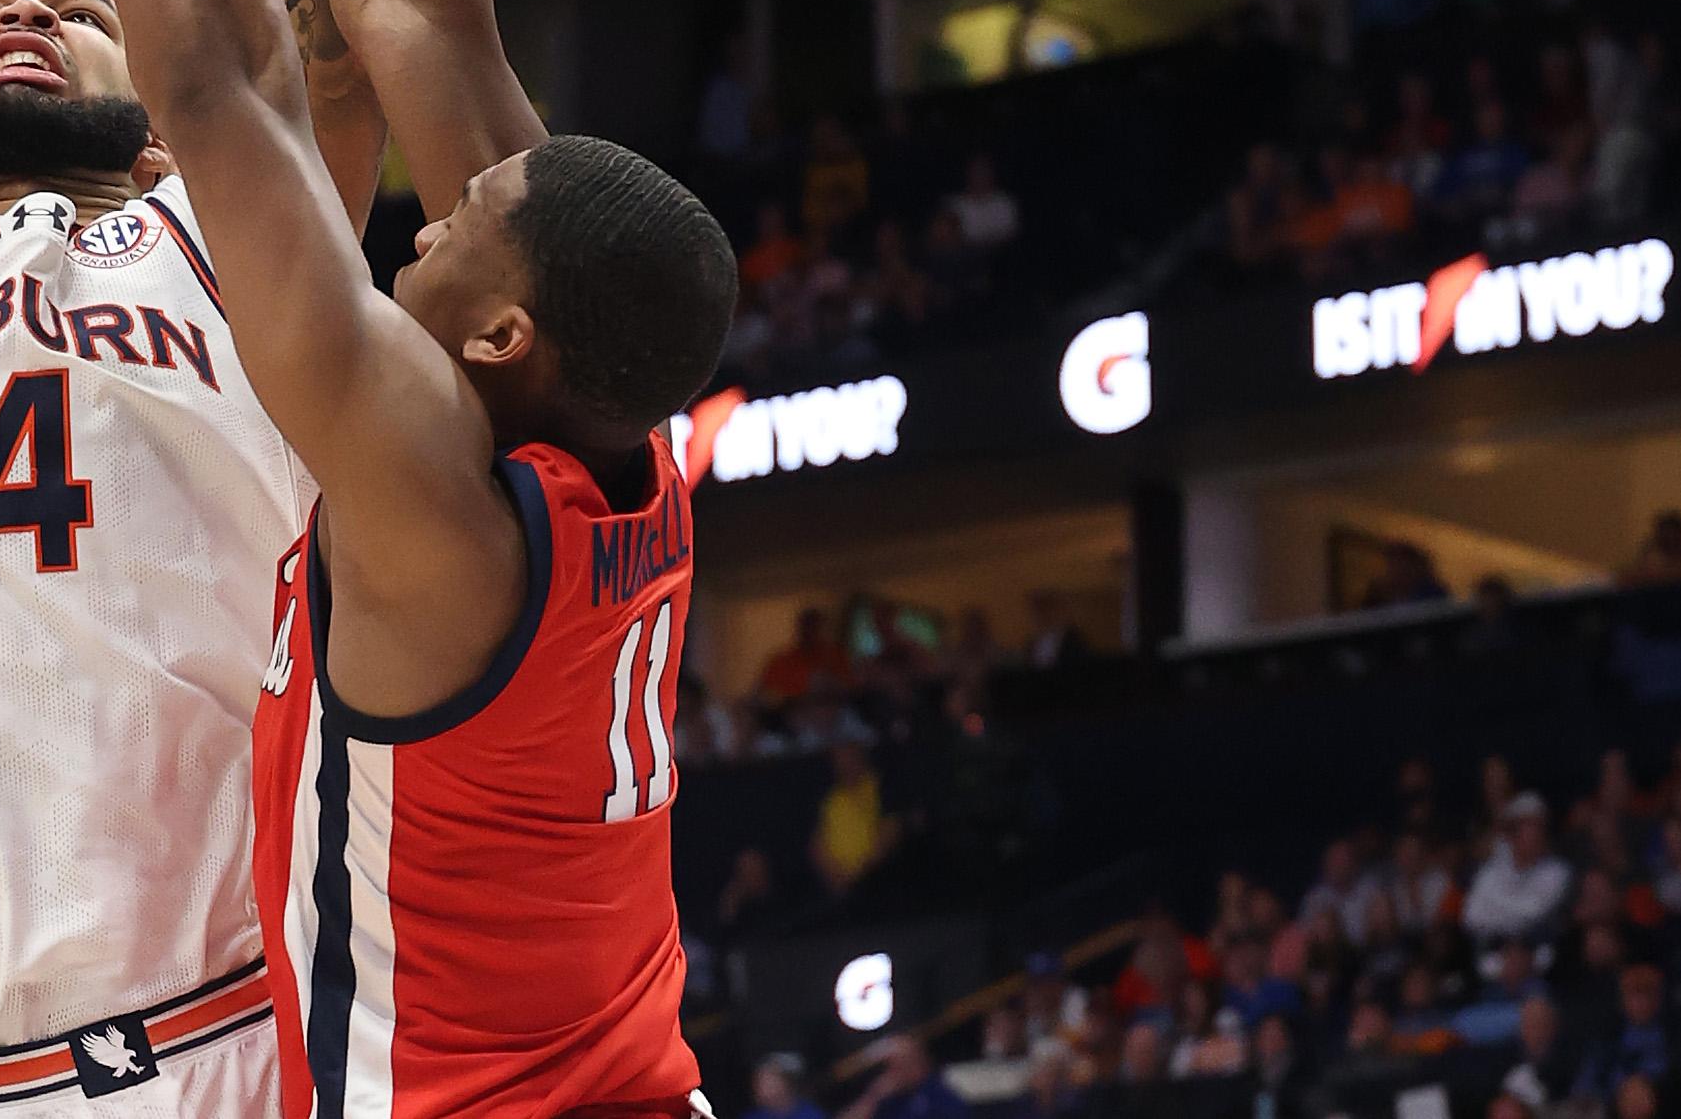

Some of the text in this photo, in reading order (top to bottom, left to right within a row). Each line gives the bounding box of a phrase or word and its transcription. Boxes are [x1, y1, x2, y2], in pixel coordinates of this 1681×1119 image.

[80, 239, 152, 267] GRADUATE
[81, 216, 141, 255] SEC
[603, 597, 671, 824] 11
